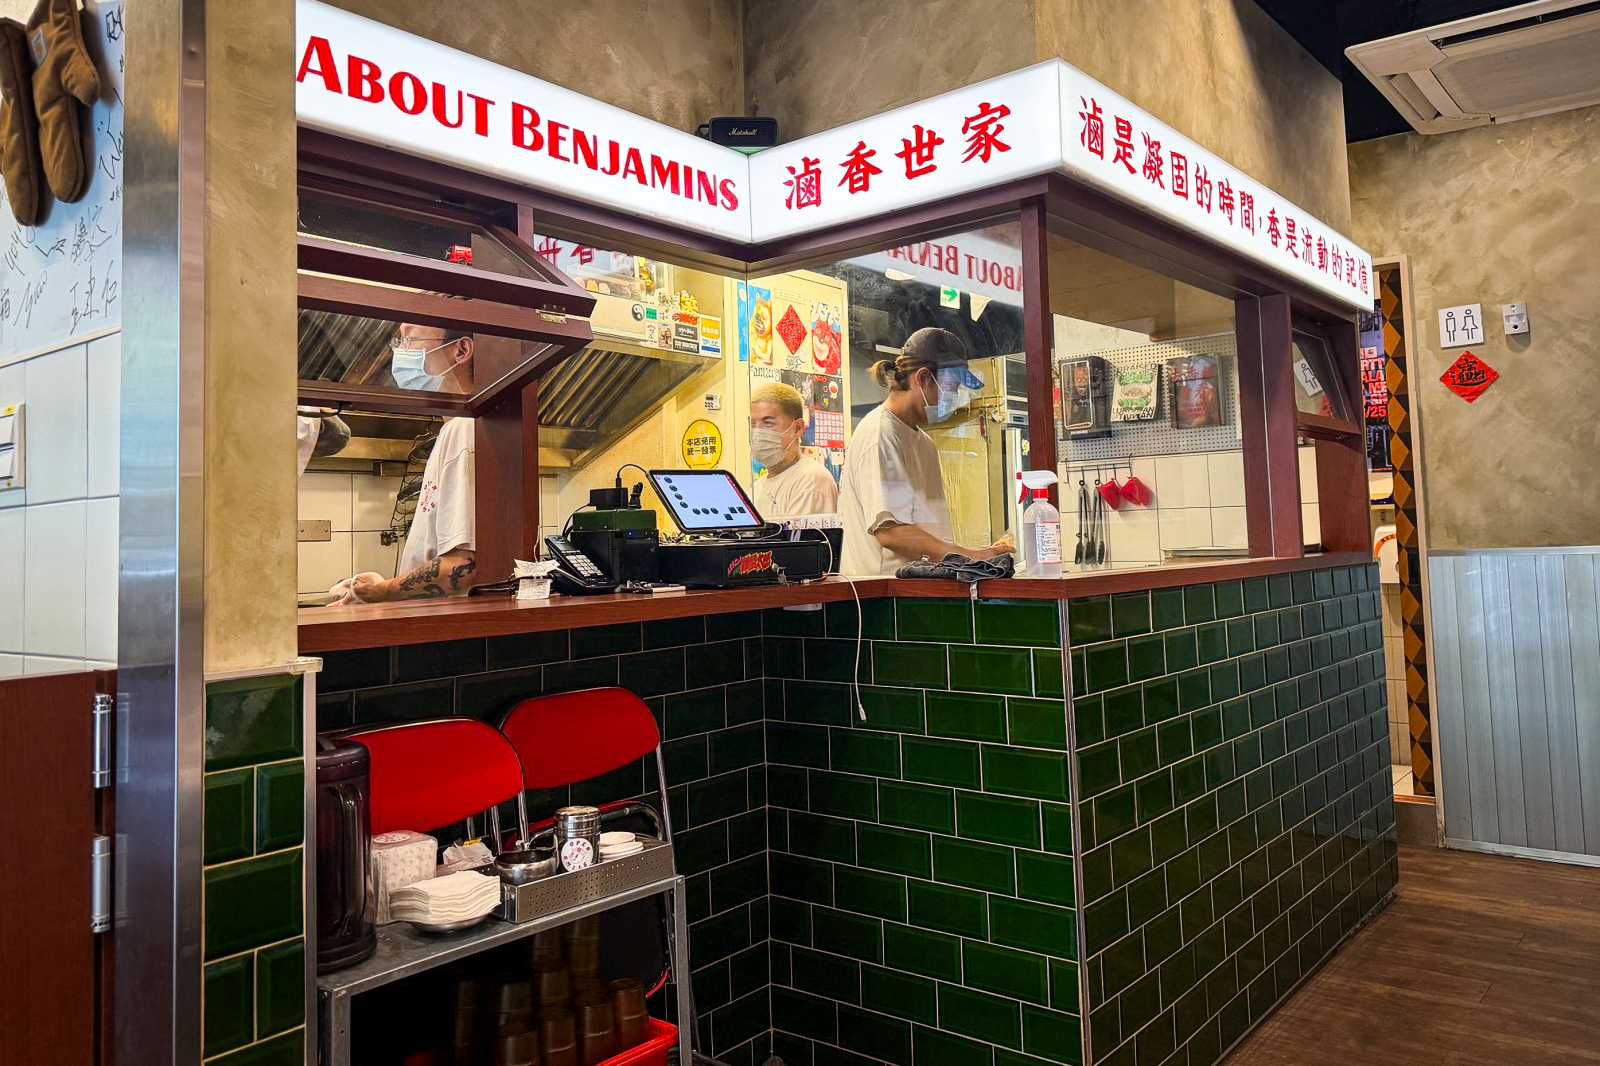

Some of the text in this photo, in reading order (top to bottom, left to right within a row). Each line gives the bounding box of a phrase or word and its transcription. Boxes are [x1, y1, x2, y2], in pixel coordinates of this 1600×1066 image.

[296, 36, 739, 212] ABOUT BENJAMINS
[783, 102, 1012, 210] 滷香世家
